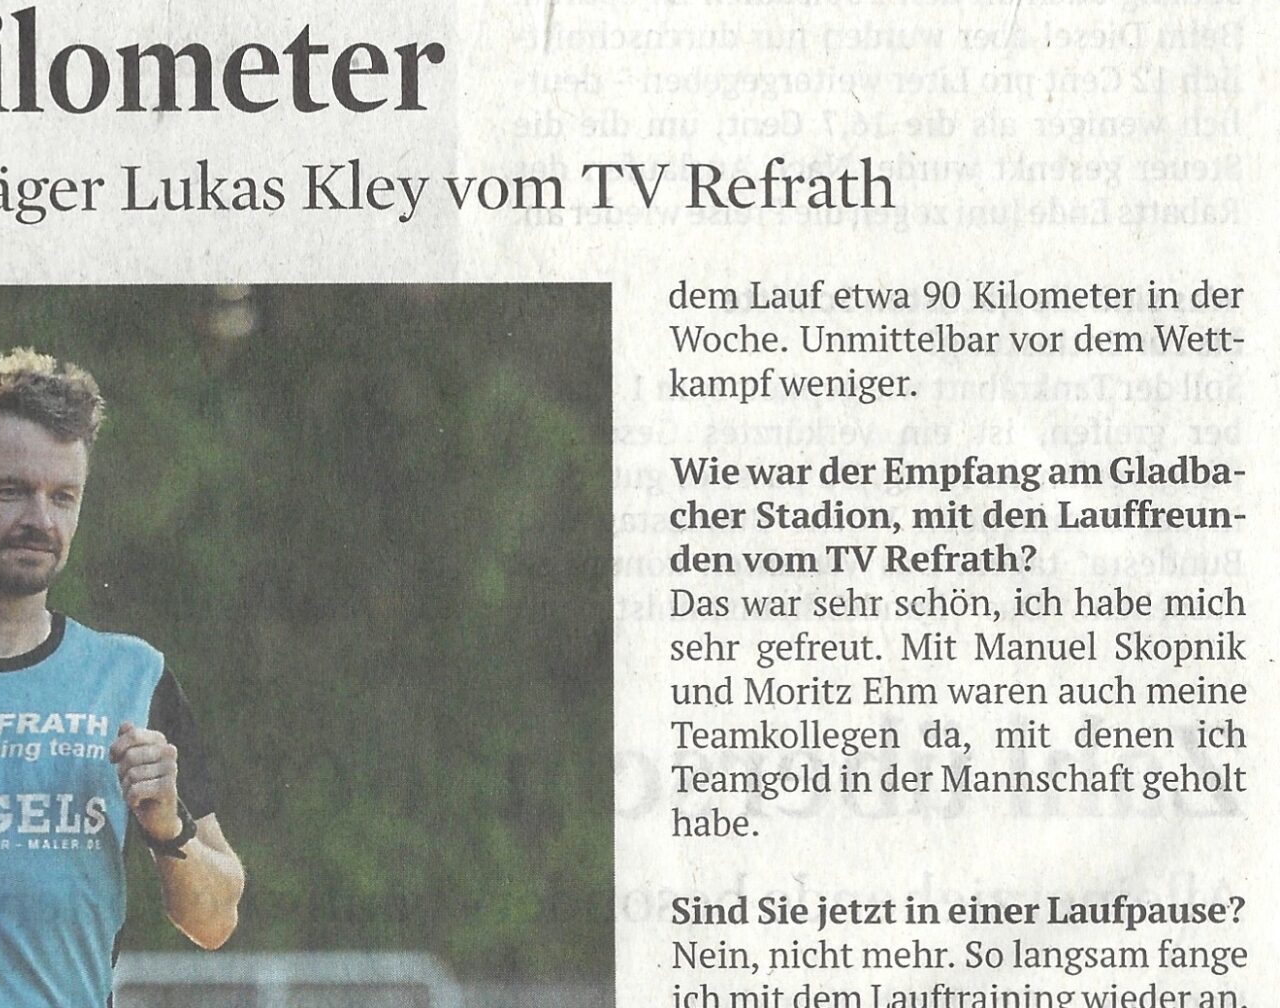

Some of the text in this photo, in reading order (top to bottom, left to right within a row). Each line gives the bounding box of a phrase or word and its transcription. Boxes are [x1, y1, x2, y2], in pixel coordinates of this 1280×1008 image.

[120, 158, 285, 211] Lukas
[302, 158, 430, 223] Kley
[443, 176, 566, 210] vom
[581, 163, 670, 209] TV
[686, 156, 896, 209] Refrath
[669, 323, 1245, 353] Woche. Unmittelbar vor dem Wett-
[670, 454, 1246, 493] Wie war der Empfang am Gladba-
[670, 499, 1246, 535] cher Stadion, mit den Lauffreun-
[670, 543, 736, 573] den
[742, 552, 819, 573] vom
[825, 545, 878, 573] TV
[884, 543, 1037, 573] Refrath?
[49, 737, 106, 760] team
[671, 718, 1247, 757] Teamkollegen da, mit denen ich
[672, 894, 1246, 932] Sind Sie jetzt in einer Laufpause?
